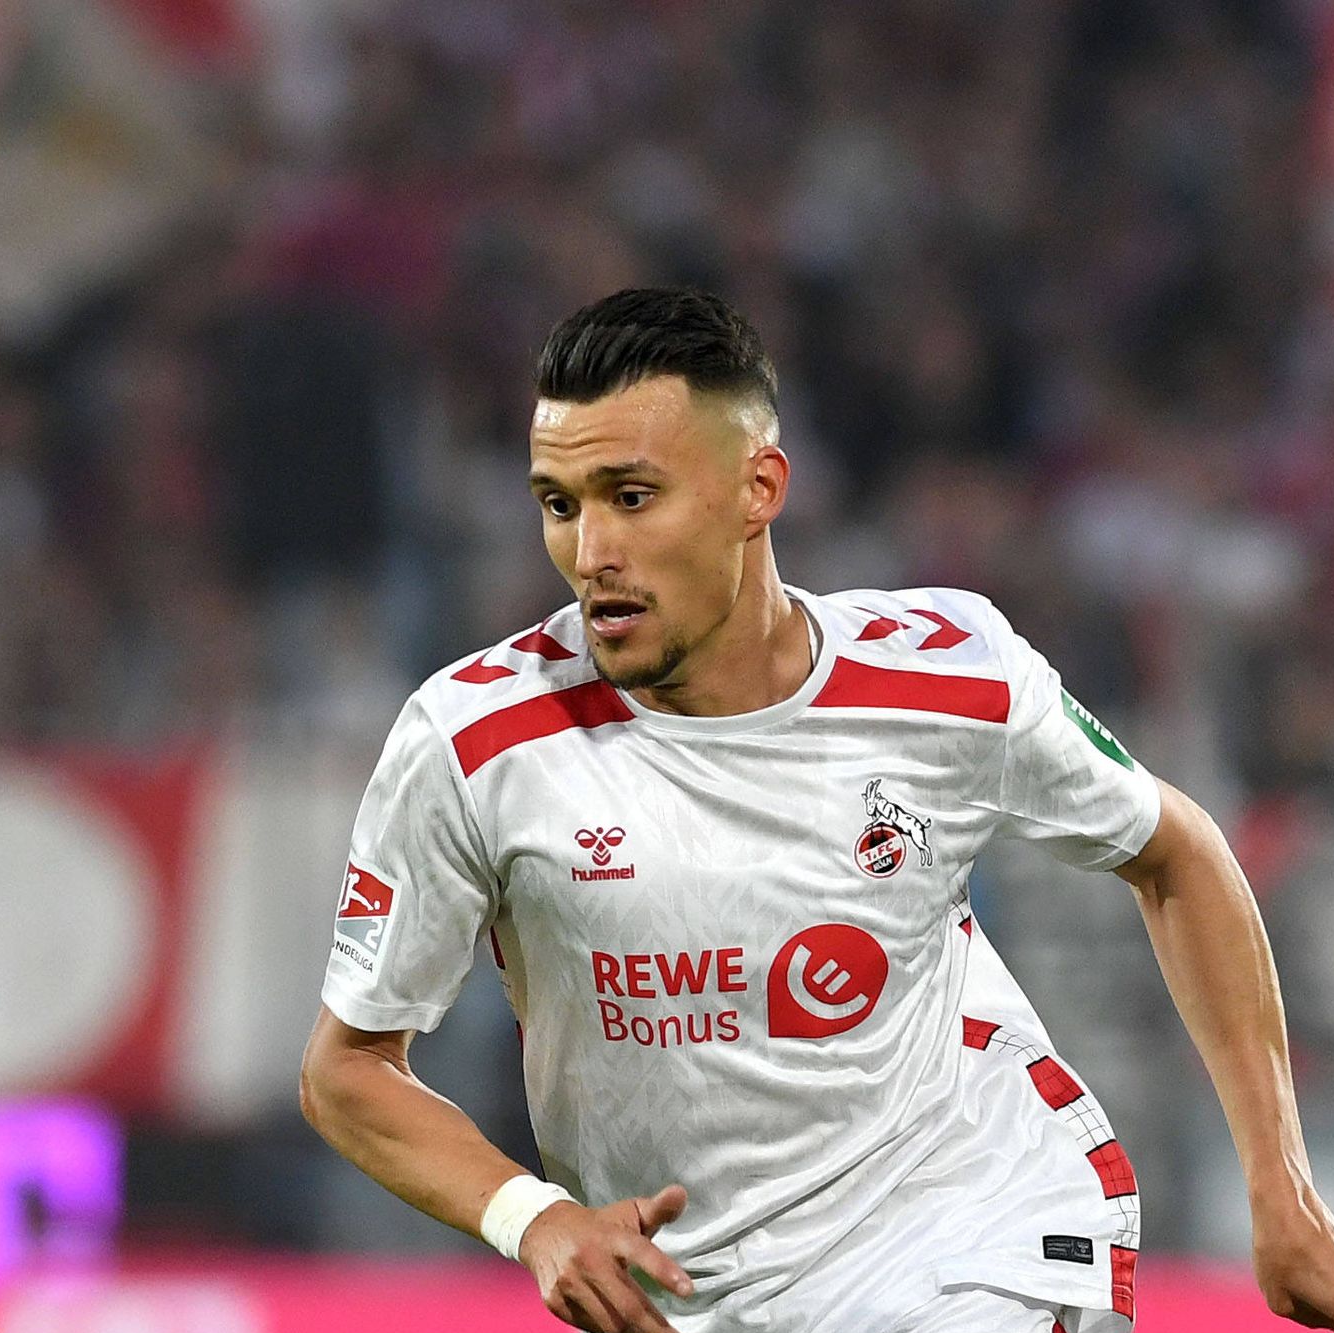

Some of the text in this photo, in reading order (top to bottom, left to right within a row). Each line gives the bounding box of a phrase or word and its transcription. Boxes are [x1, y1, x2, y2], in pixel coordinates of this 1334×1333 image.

[571, 863, 635, 882] hummel
[331, 940, 374, 974] NDESLIGA
[591, 947, 748, 999] REWE
[597, 999, 741, 1049] Bonus
